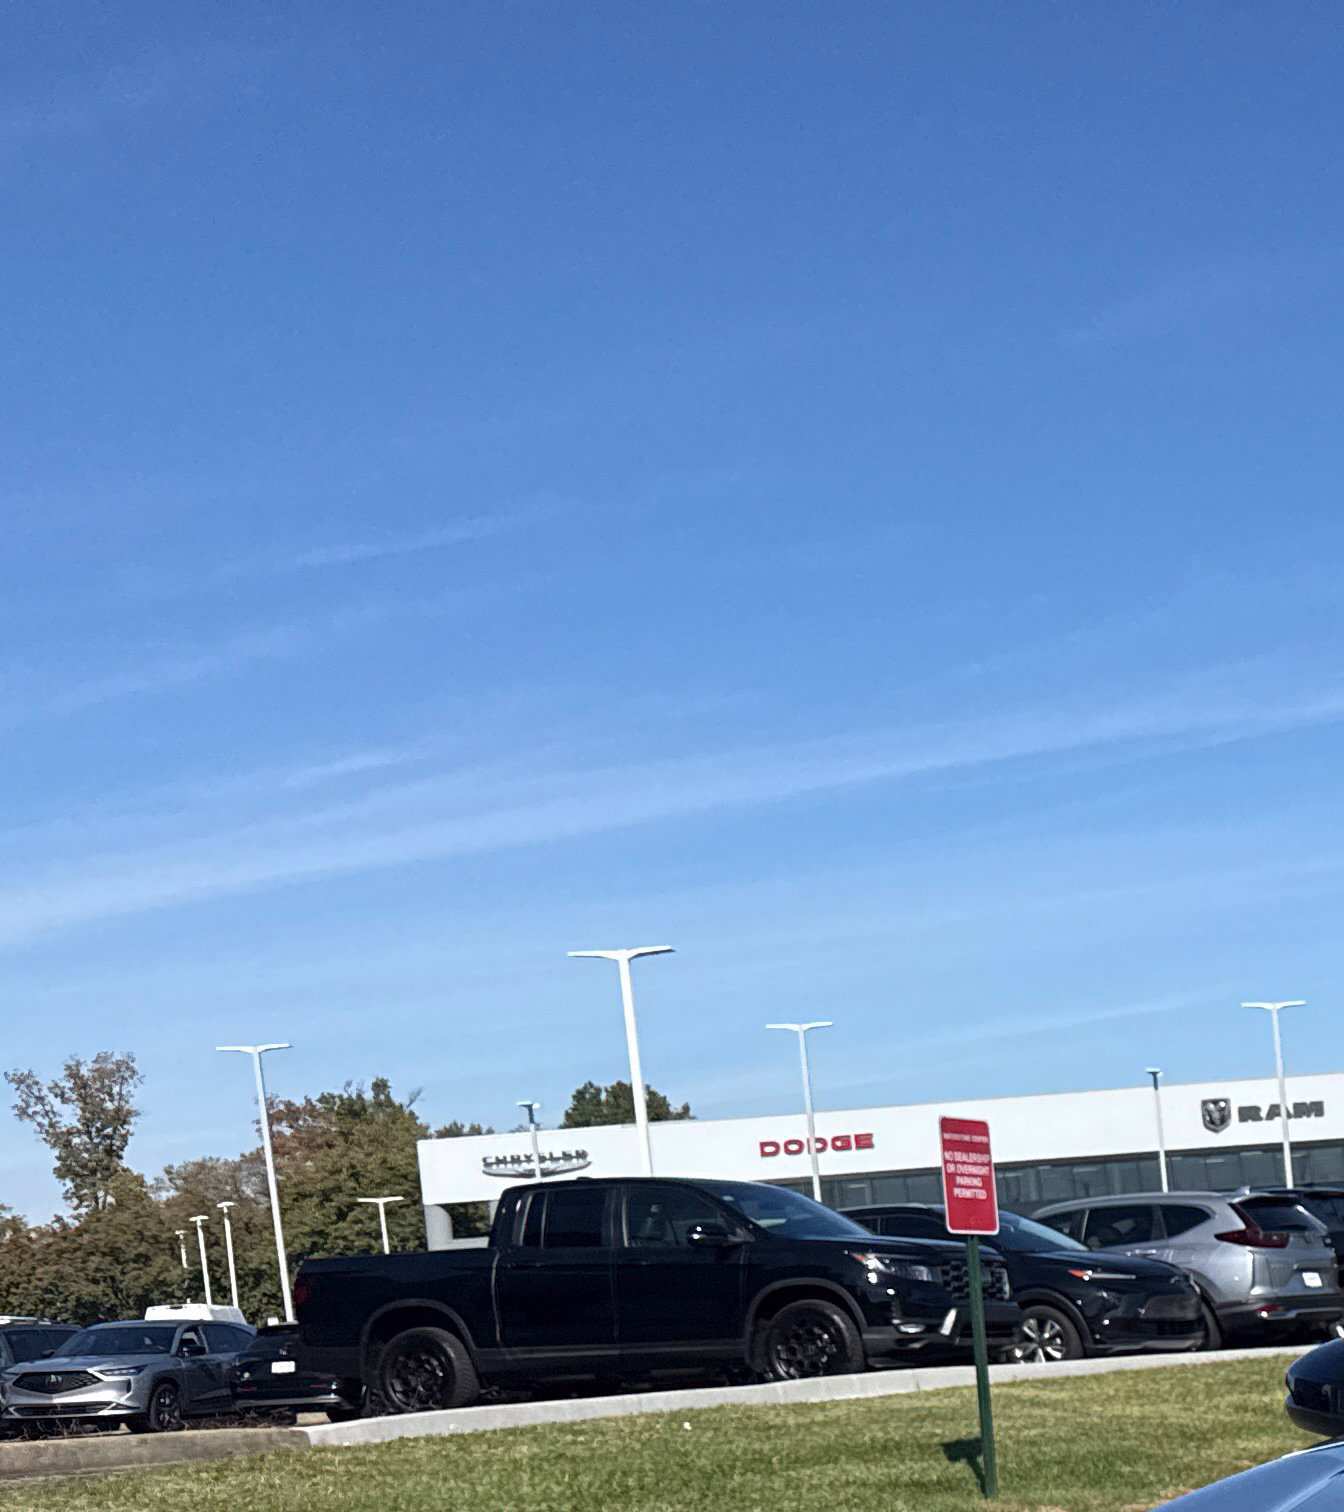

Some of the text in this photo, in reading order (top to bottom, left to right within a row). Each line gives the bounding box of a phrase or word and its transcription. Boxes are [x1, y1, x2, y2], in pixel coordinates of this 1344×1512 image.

[1238, 1100, 1325, 1123] RAM
[759, 1133, 875, 1158] DODGE
[482, 1149, 589, 1168] CHRYSLER
[944, 1150, 990, 1164] NO DEALERSHIP
[946, 1162, 990, 1176] OR OVERNIGHT
[956, 1176, 983, 1187] PARKING
[953, 1187, 987, 1200] PERMITTED
